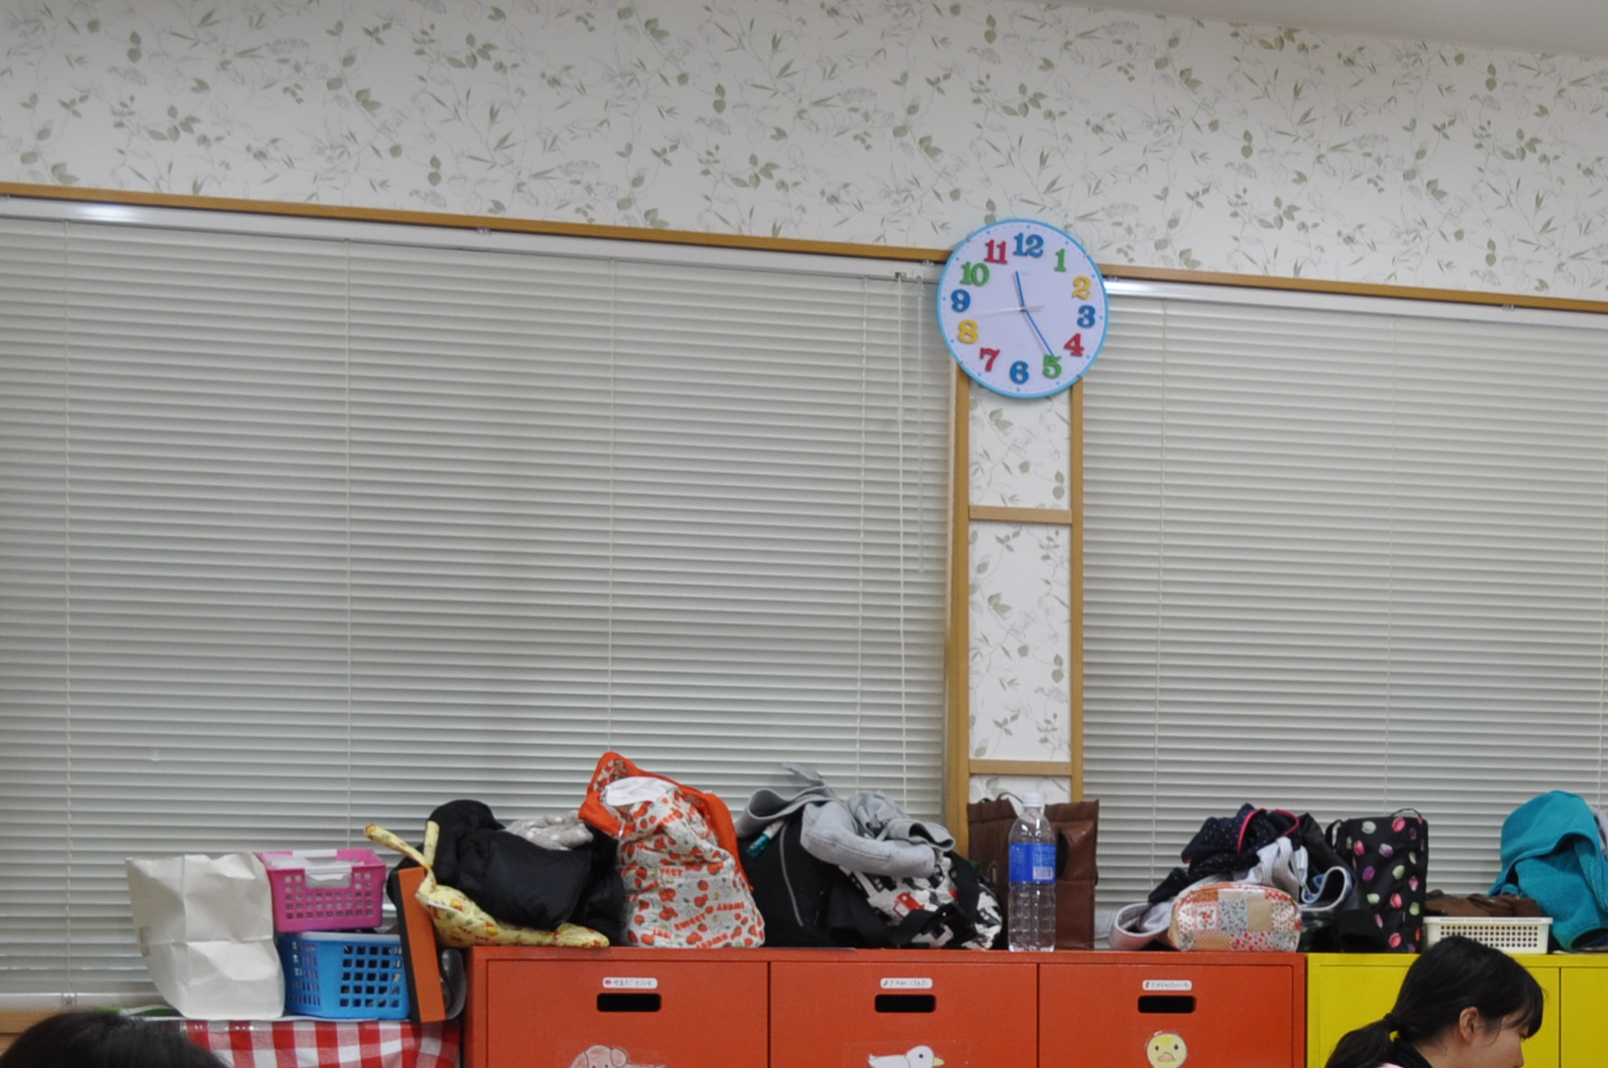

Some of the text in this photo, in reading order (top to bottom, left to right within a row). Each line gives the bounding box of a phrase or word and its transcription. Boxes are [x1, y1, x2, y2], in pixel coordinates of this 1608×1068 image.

[984, 239, 1008, 264] 11
[1012, 232, 1044, 258] 12
[1054, 248, 1067, 272] 1
[960, 261, 990, 286] 10
[1072, 275, 1092, 300] 2
[951, 289, 971, 312] 9
[1076, 305, 1096, 328] 3
[957, 320, 979, 343] 8
[1063, 333, 1084, 357] 4
[979, 347, 1001, 372] 7
[1042, 354, 1062, 378] 5
[1009, 361, 1029, 384] 6
